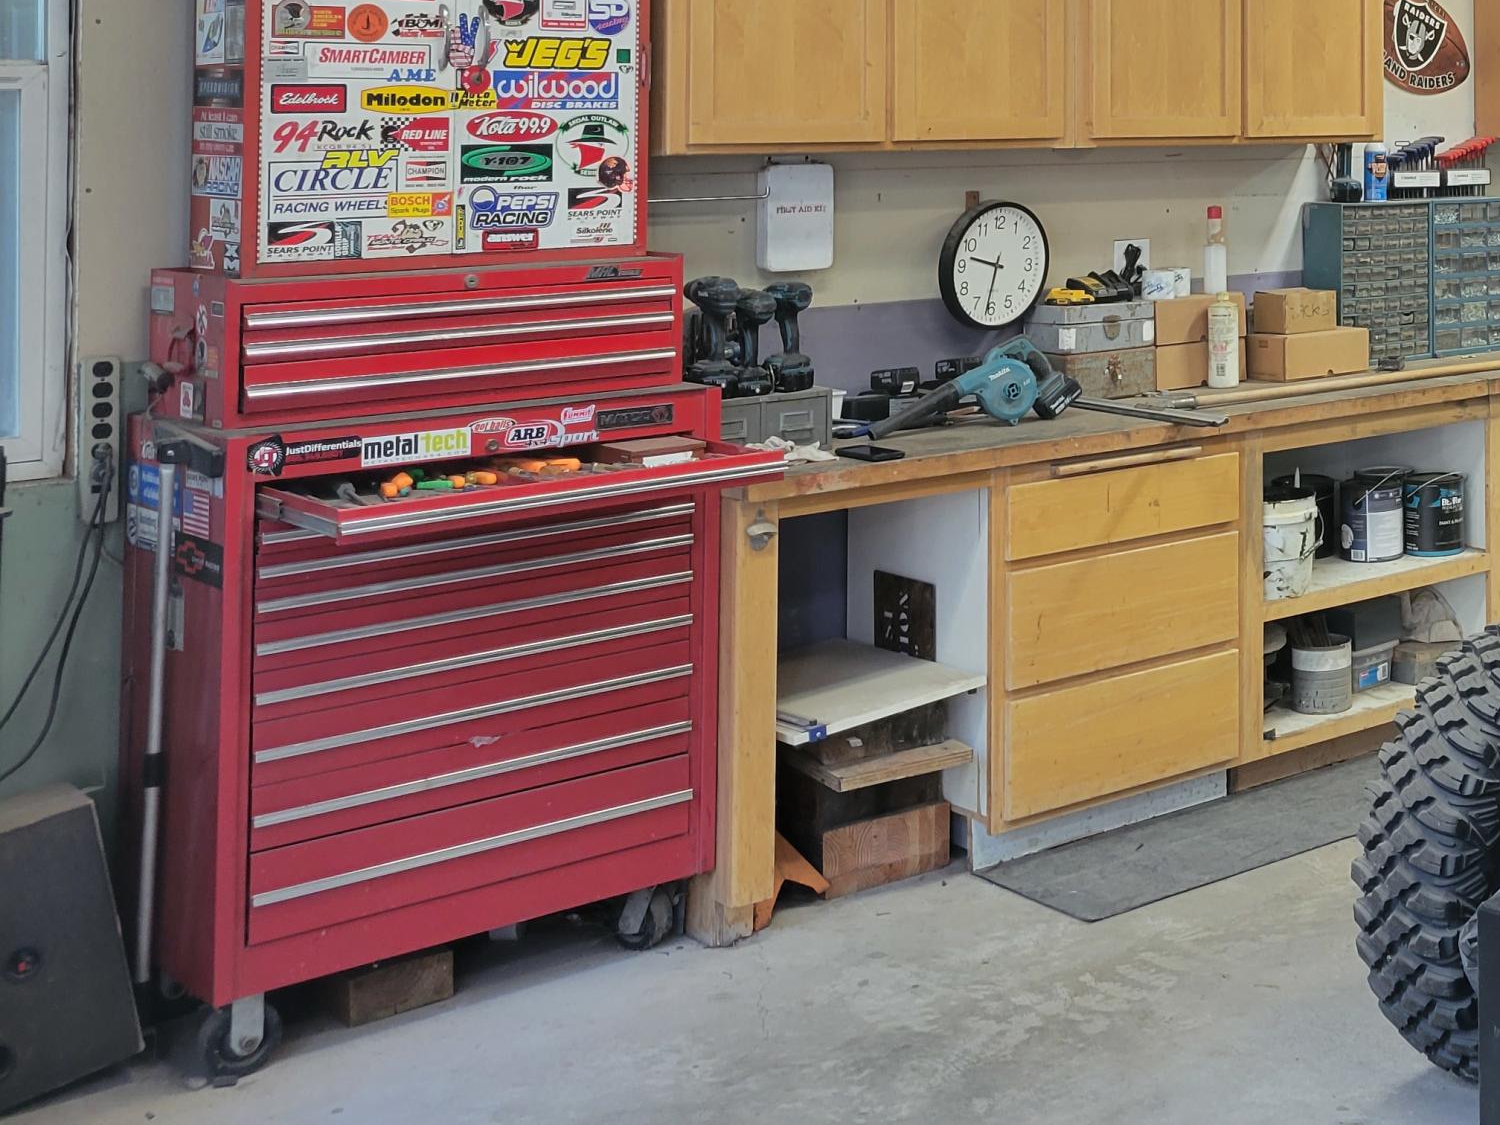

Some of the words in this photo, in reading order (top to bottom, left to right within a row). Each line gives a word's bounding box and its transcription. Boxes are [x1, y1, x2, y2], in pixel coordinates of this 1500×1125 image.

[1403, 2, 1441, 30] RAIDERS
[504, 37, 611, 70] JEG'S
[497, 72, 616, 100] wilwood
[1409, 72, 1455, 90] RAIDERS
[279, 92, 340, 106] Edelbrock
[366, 92, 446, 106] Milodon
[460, 98, 496, 107] Meter
[531, 101, 564, 109] DISC
[565, 101, 617, 109] BRAKES
[518, 116, 551, 135] 99.9
[273, 120, 320, 153] 94
[401, 129, 423, 140] RED
[424, 129, 448, 140] LINE
[209, 156, 241, 181] NASCAR
[407, 166, 446, 175] CHAMPION
[274, 167, 392, 192] CIRCLE
[273, 202, 329, 214] RACING
[391, 196, 430, 207] BOSCH
[496, 194, 556, 211] PEPSI
[798, 205, 813, 213] AID
[475, 211, 549, 226] RACING
[568, 210, 595, 218] SEARS
[978, 223, 988, 237] 11
[994, 215, 1006, 230] 12
[963, 238, 977, 252] 10
[1022, 235, 1031, 250] 2
[267, 246, 300, 256] SEARS
[302, 245, 334, 254] POINT
[957, 259, 966, 274] 9
[1024, 257, 1033, 272] 3
[960, 281, 969, 296] 8
[1017, 279, 1026, 293] 4
[973, 296, 981, 311] 7
[987, 301, 996, 316] 6
[1004, 295, 1013, 309] 5
[510, 427, 546, 442] ARB
[285, 439, 363, 457] JustDifferentials
[363, 433, 419, 461] metal
[420, 429, 469, 452] tech
